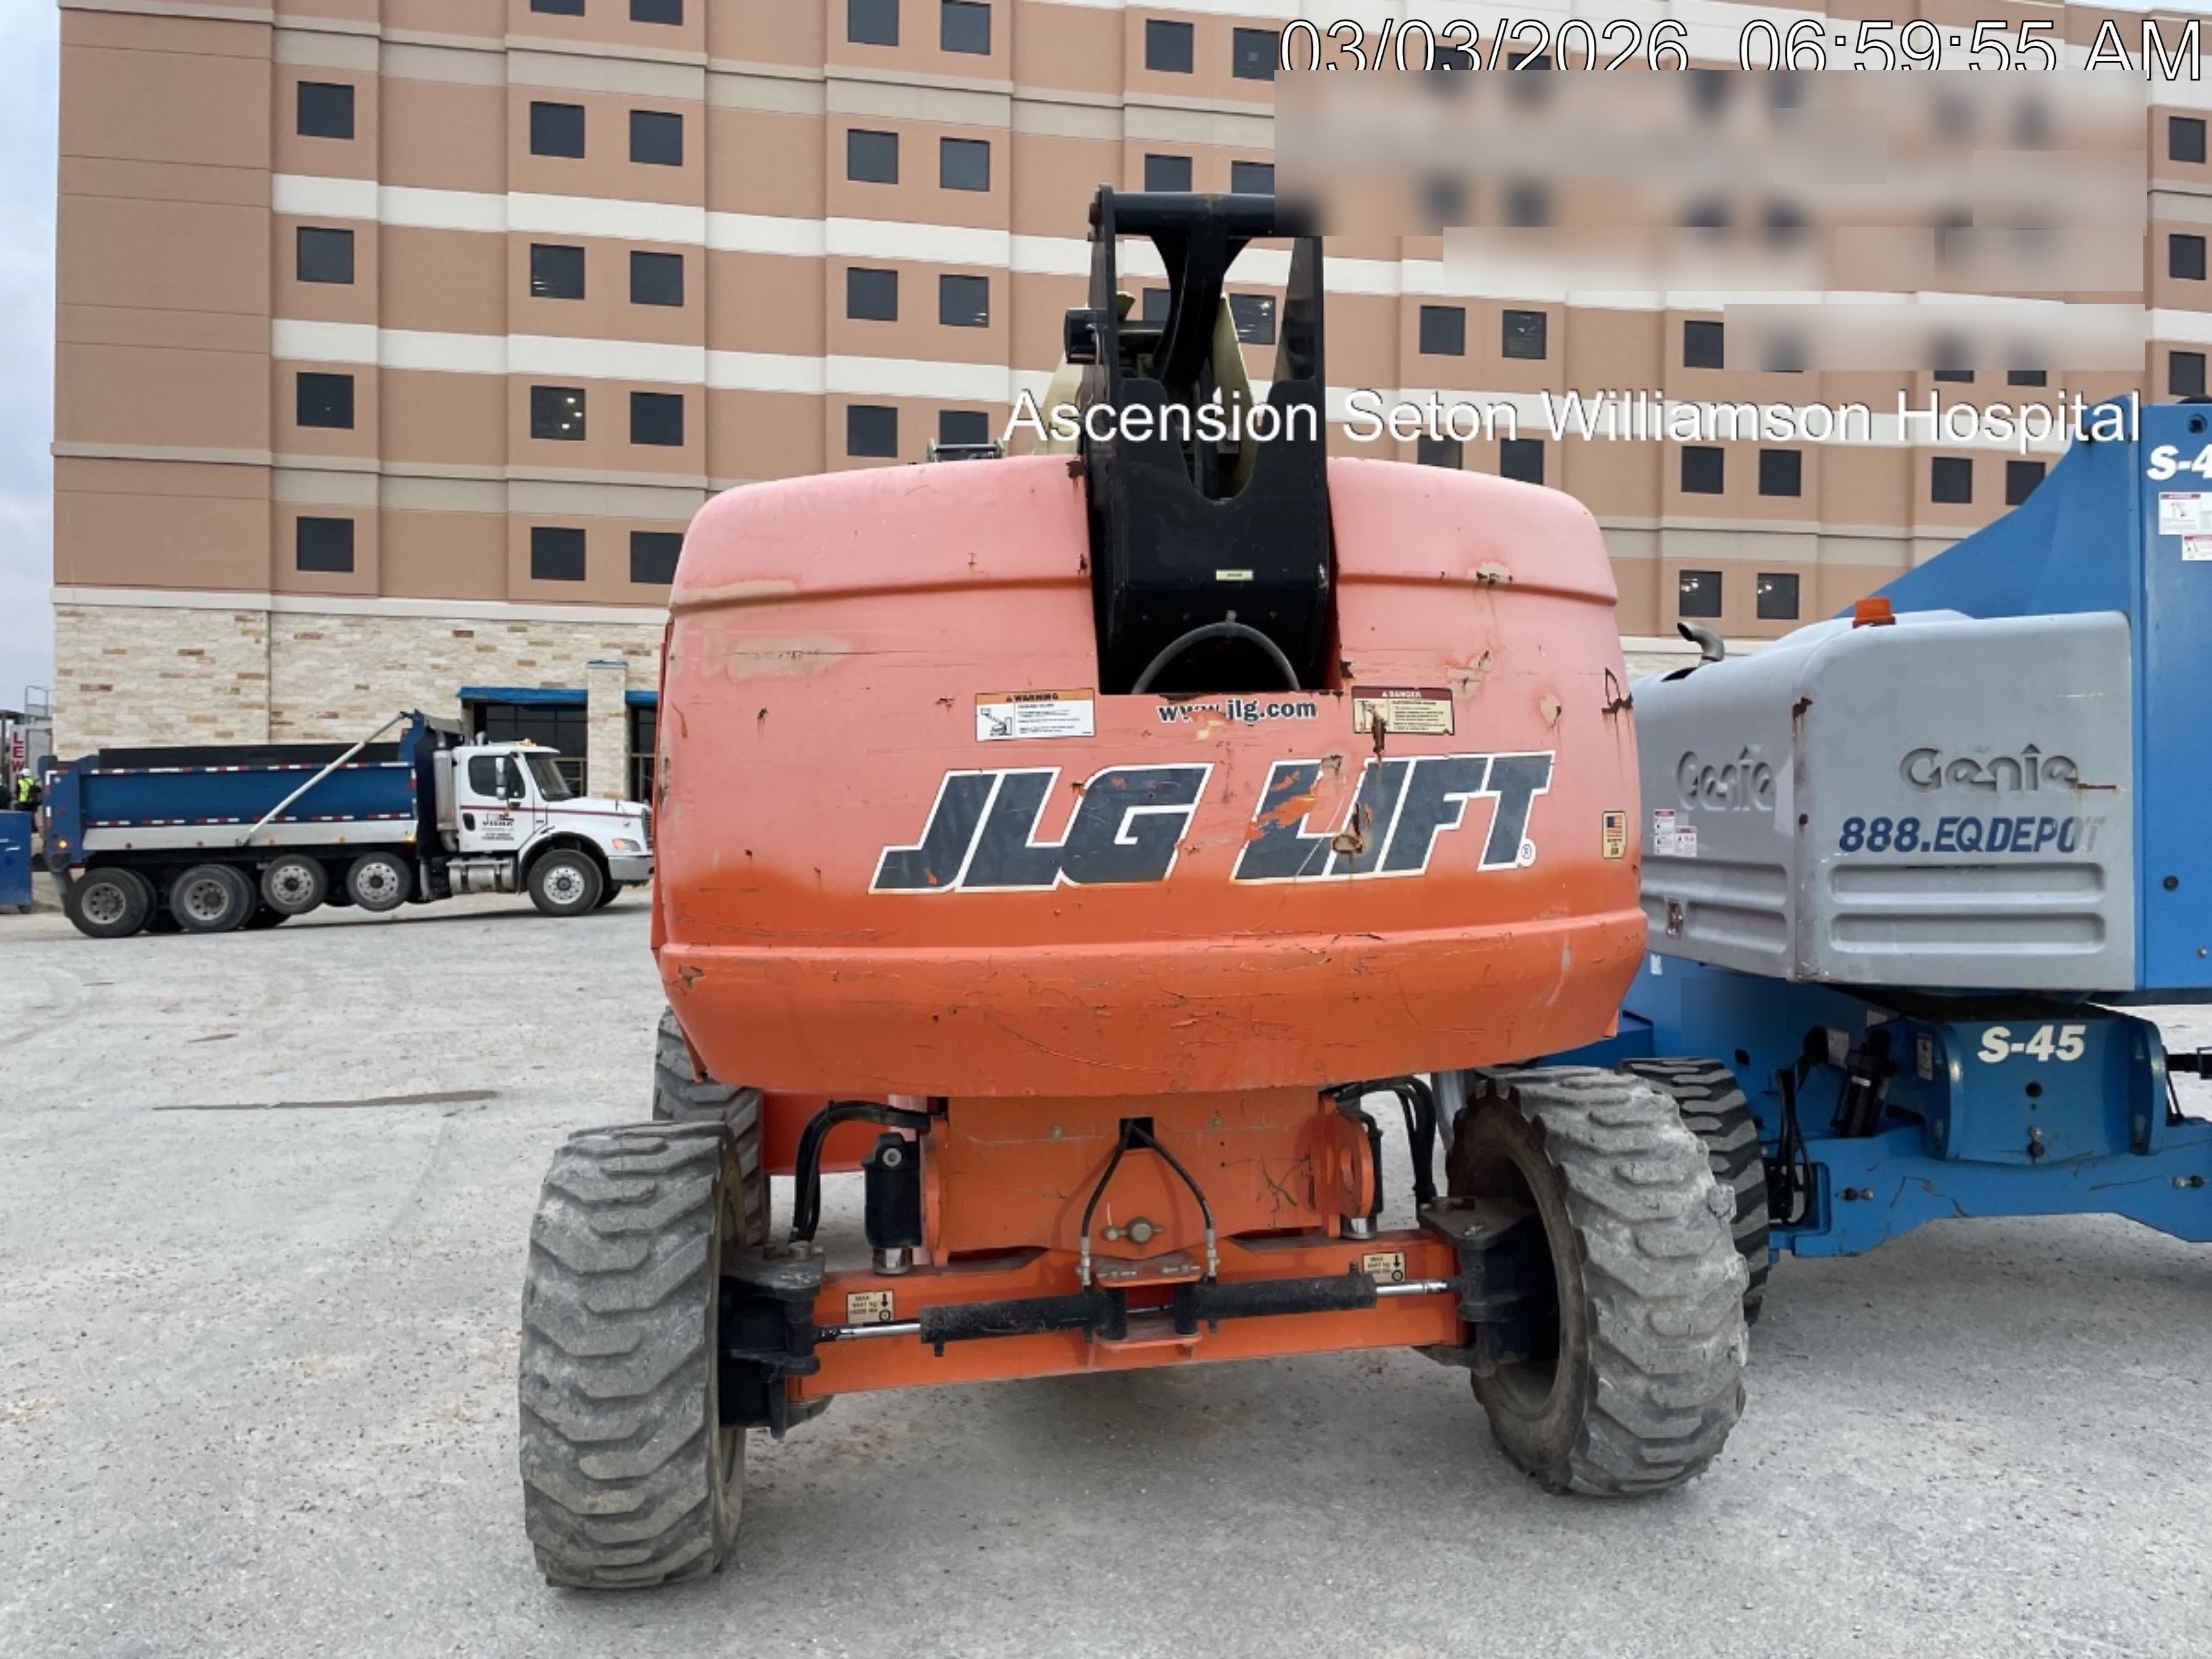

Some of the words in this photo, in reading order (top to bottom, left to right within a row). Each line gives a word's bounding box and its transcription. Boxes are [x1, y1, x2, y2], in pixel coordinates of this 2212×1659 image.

[1014, 693, 1059, 702] WARNING
[1677, 745, 1777, 812] Genie
[1900, 743, 2079, 793] Genie
[868, 763, 1215, 895] JLG
[1977, 1024, 2087, 1064] S-45
